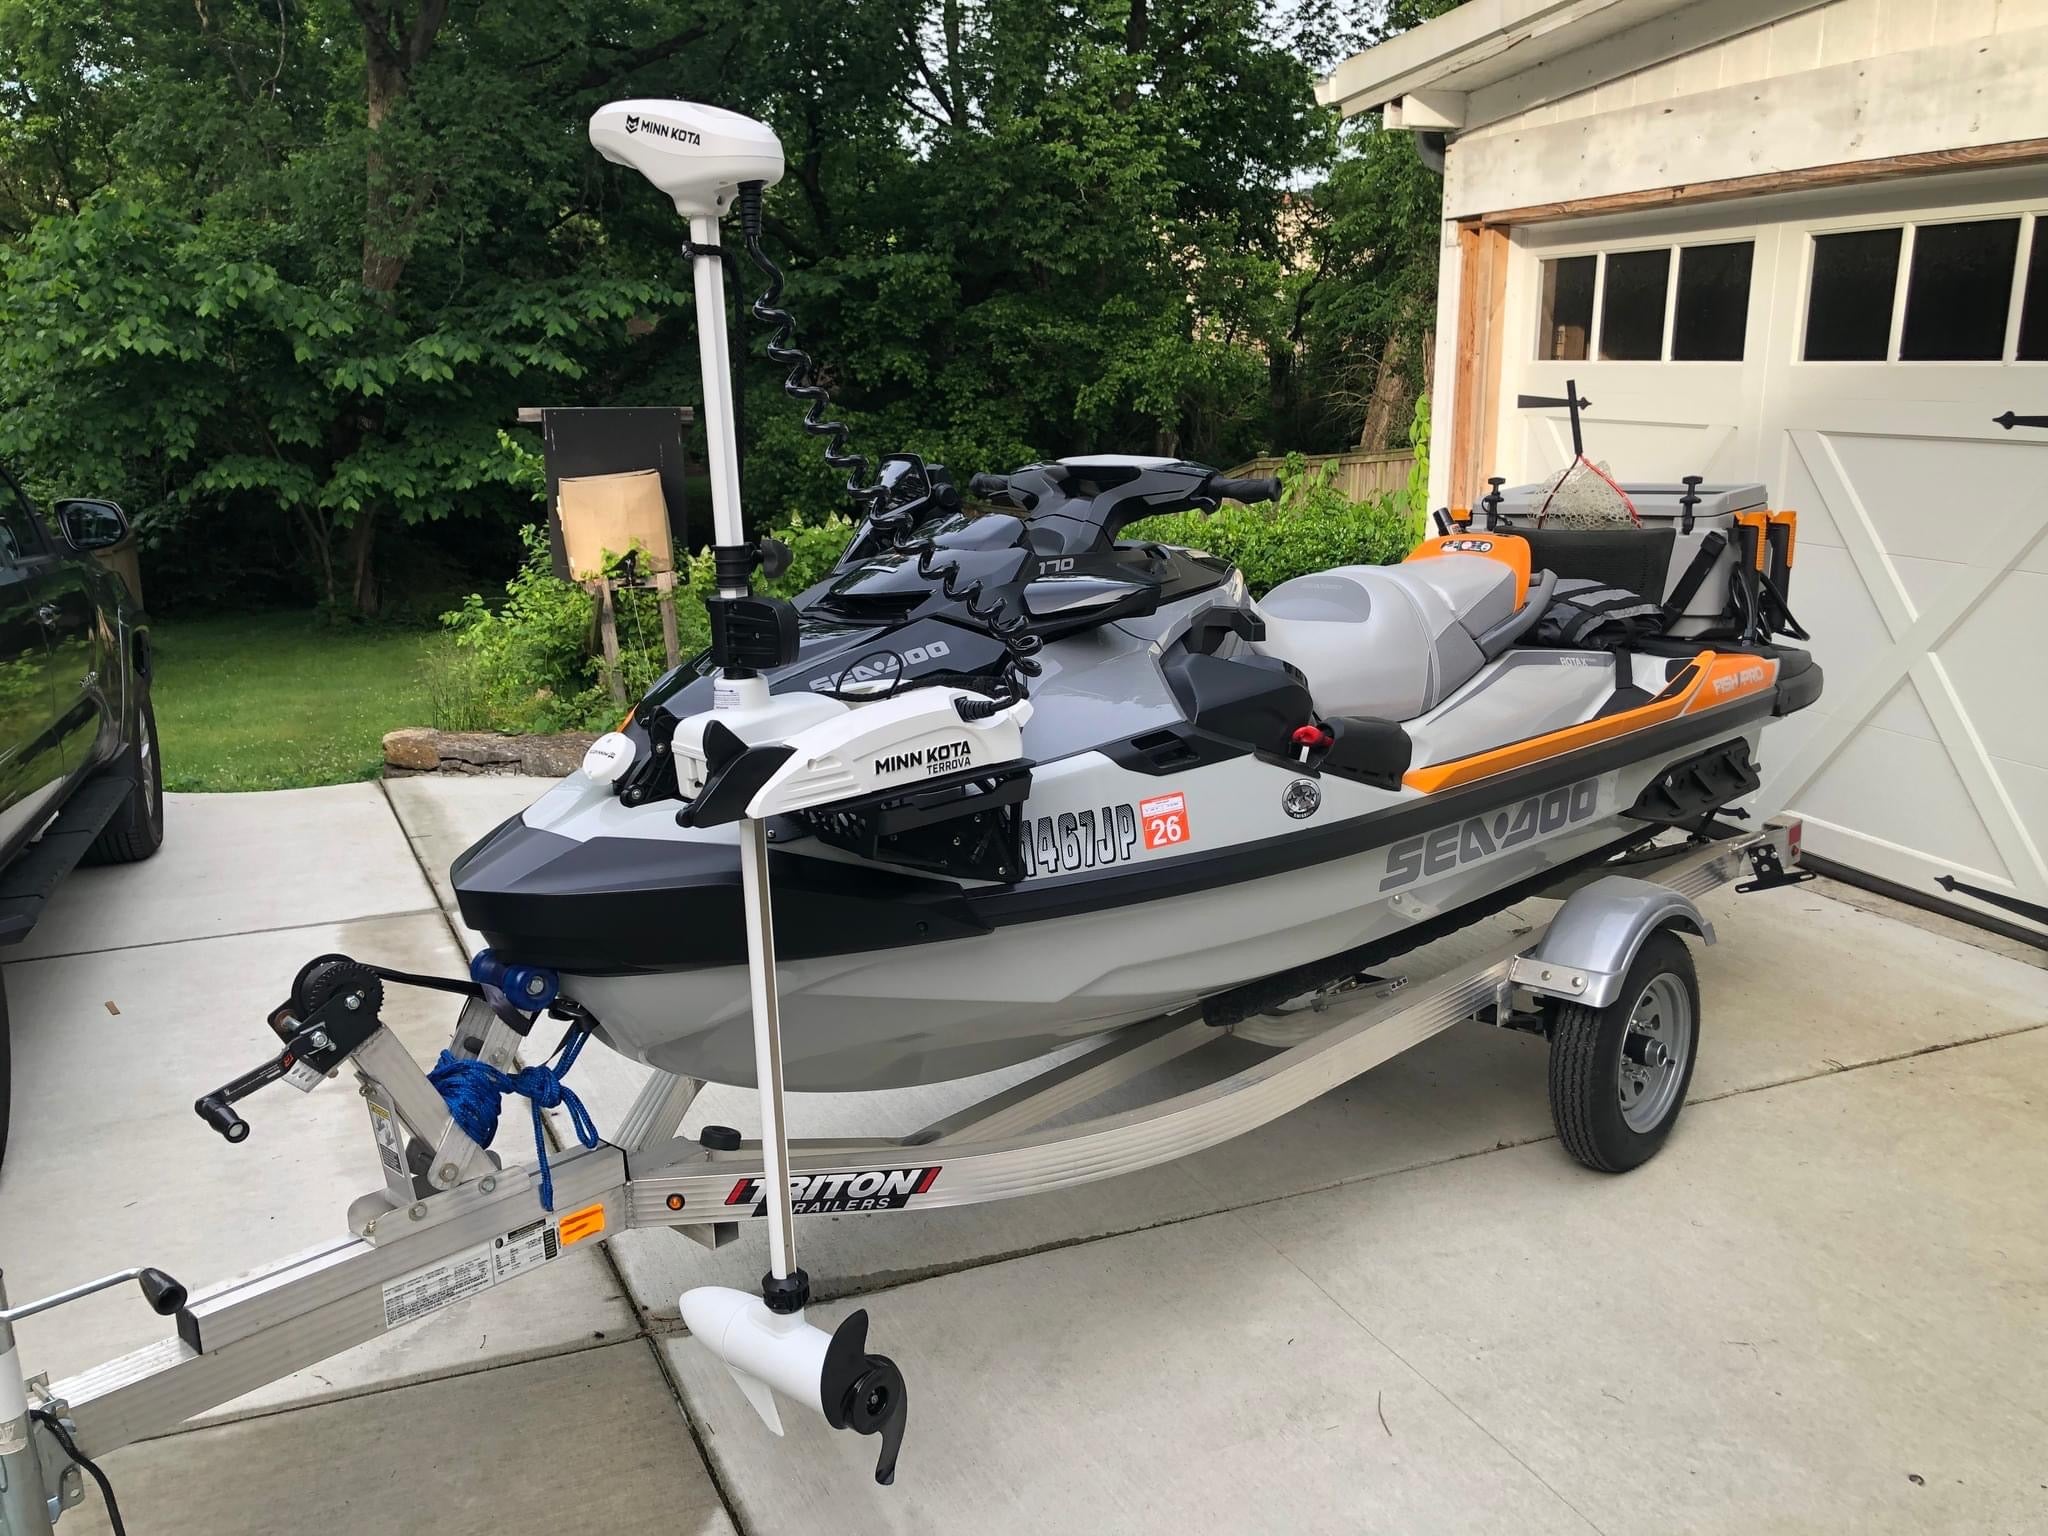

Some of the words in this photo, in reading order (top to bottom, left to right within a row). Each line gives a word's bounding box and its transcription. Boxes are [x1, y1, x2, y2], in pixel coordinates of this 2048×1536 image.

[641, 119, 669, 138] MINN
[671, 127, 701, 146] KOTA
[1039, 557, 1074, 575] 170
[875, 750, 922, 775] MINN
[926, 740, 971, 763] KOTA
[926, 756, 971, 775] TERROVA
[1151, 815, 1182, 846] 26
[792, 1197, 891, 1215] RAILERS
